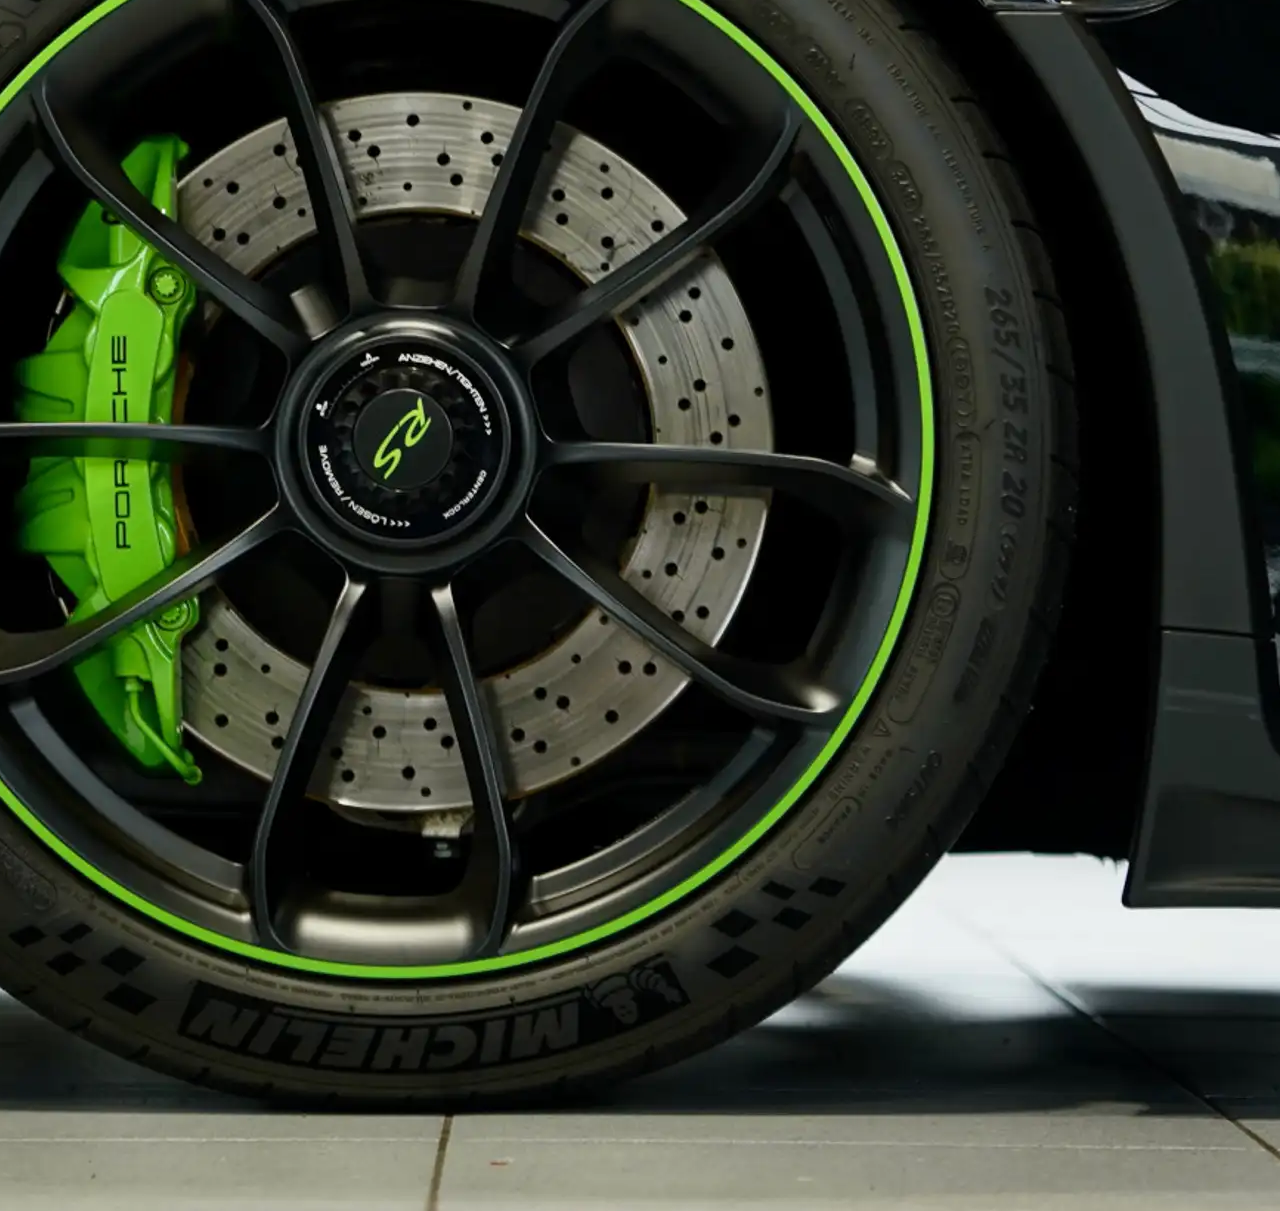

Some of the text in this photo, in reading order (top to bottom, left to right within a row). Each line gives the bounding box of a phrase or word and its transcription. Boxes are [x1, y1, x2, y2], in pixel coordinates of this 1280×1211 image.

[983, 285, 1029, 415] 265/35
[111, 335, 131, 549] PORCHE
[318, 444, 344, 496] REMOVE
[442, 469, 487, 520] CENTERLOCK
[1000, 471, 1028, 519] 20
[188, 1000, 580, 1071] MICHELIN
